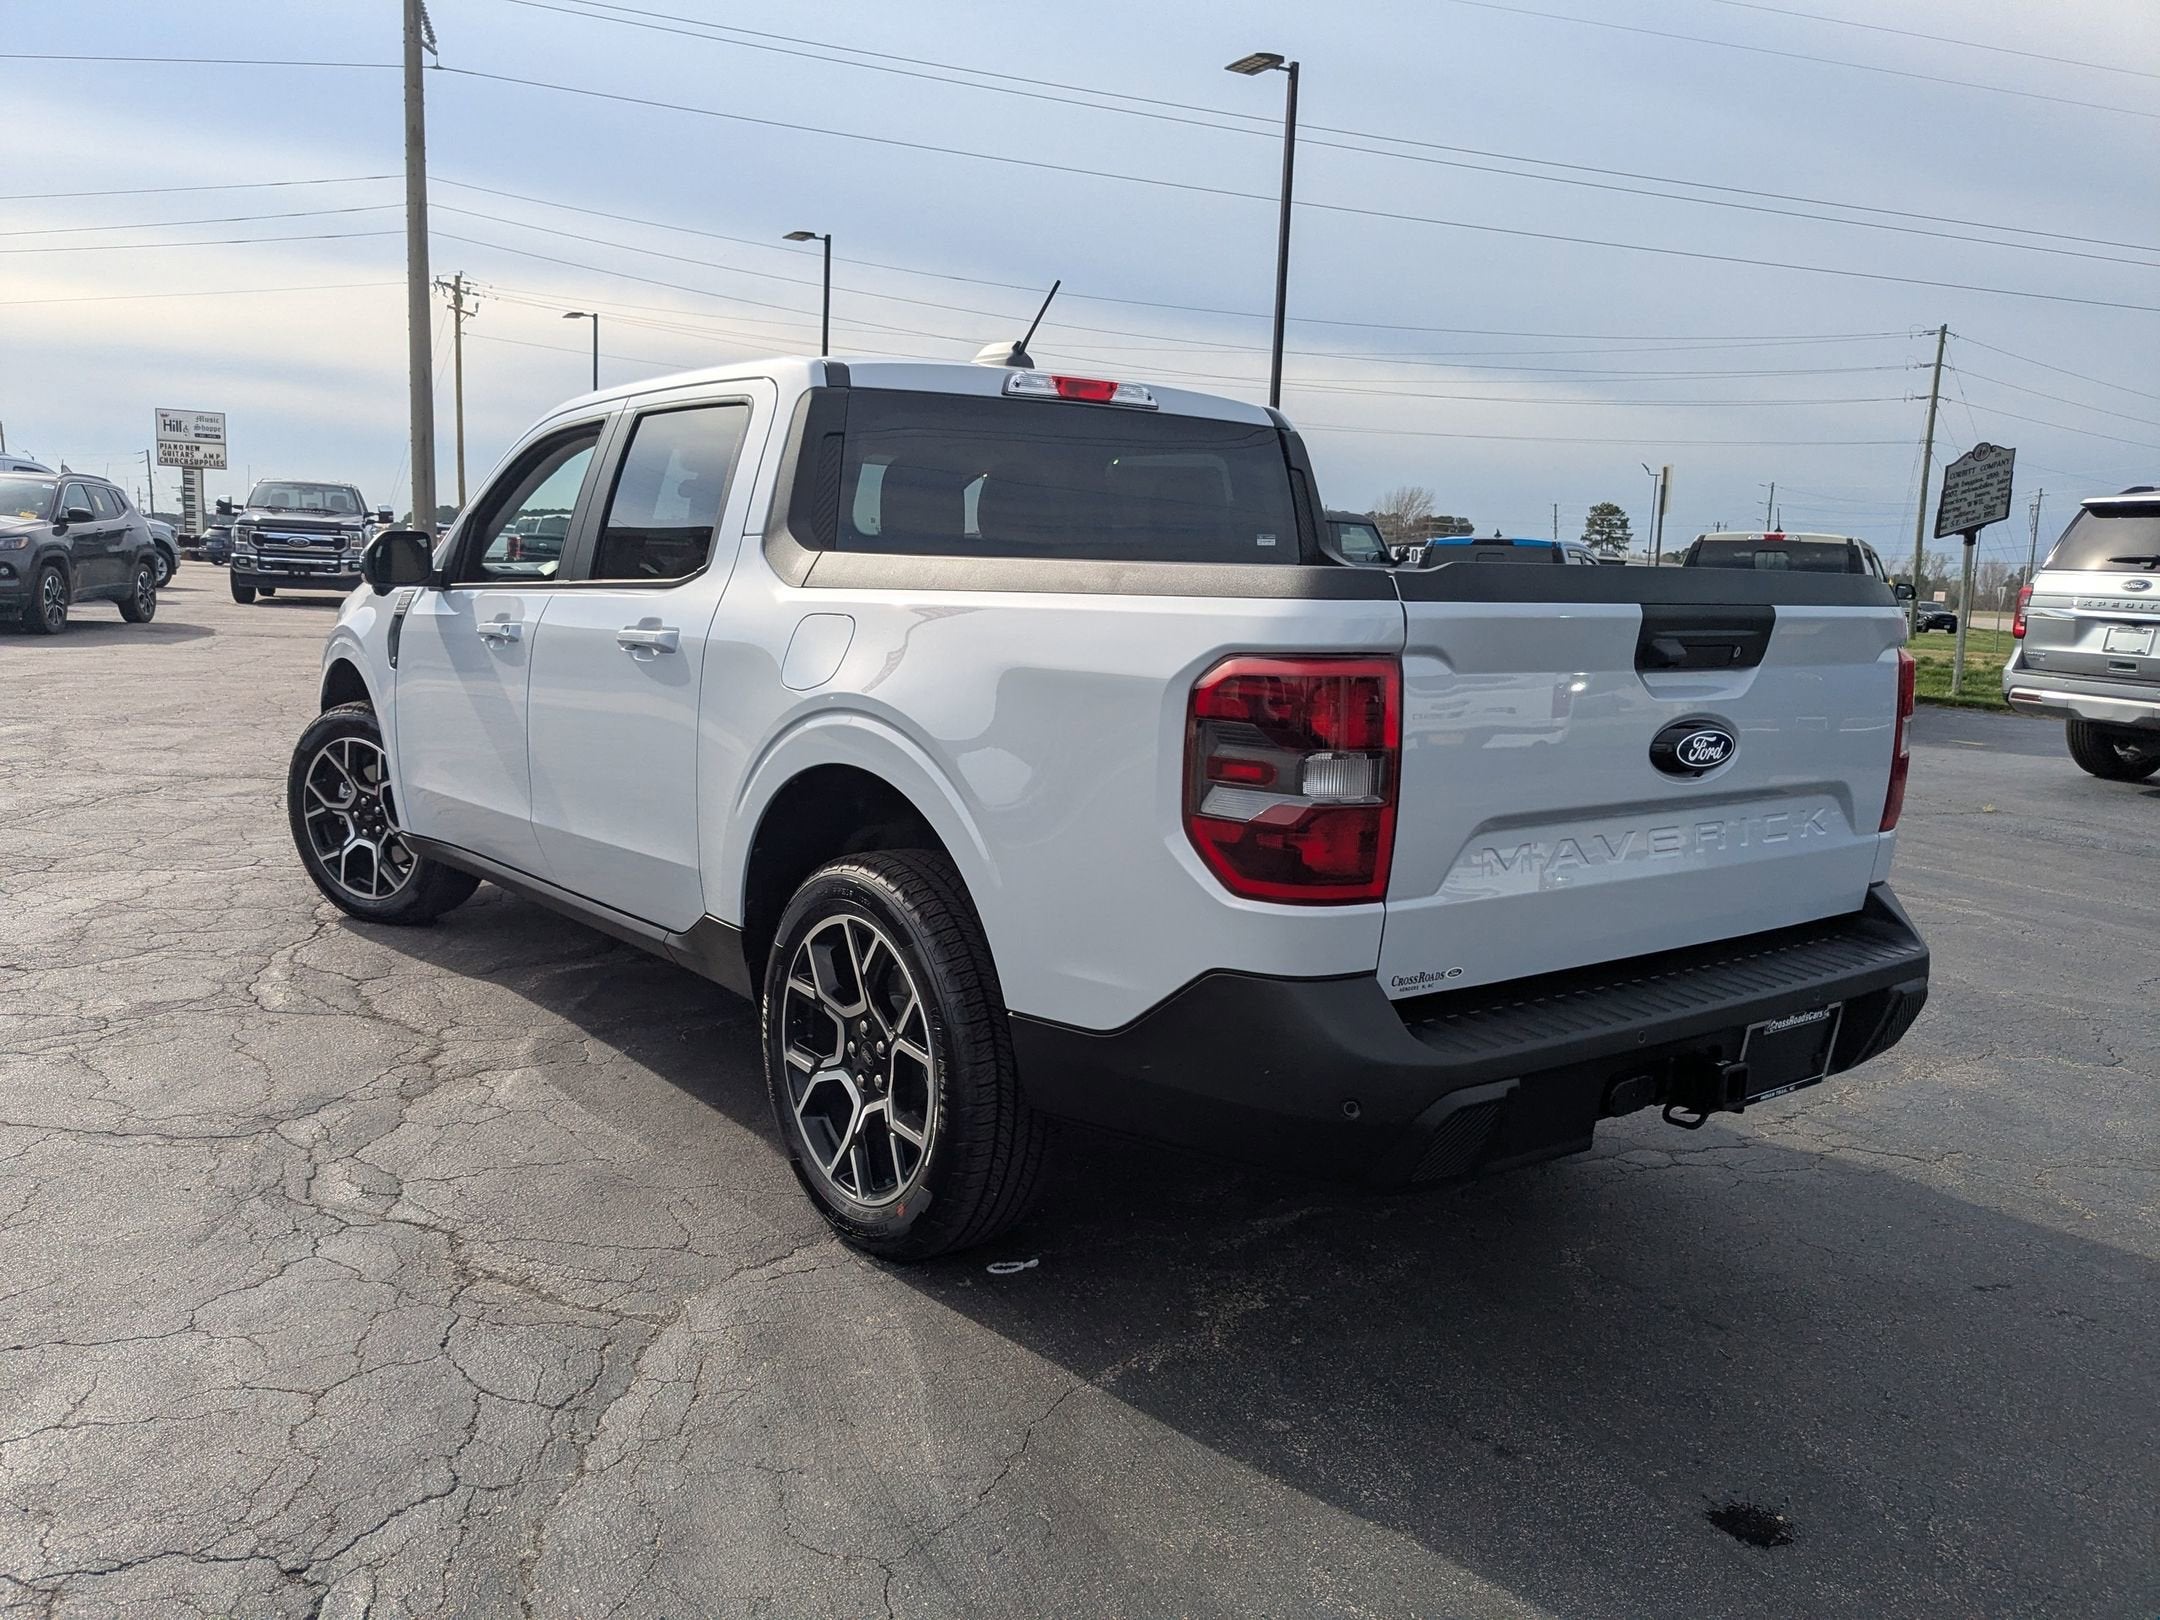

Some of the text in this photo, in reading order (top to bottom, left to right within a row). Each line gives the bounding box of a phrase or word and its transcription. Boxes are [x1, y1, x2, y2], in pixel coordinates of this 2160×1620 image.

[163, 419, 184, 433] Hill
[195, 416, 220, 424] Music
[193, 424, 222, 433] Shoppe
[162, 450, 195, 458] GUITARS
[159, 457, 225, 467] CHURCH SUPPLIES
[1980, 458, 2011, 472] COMPANY
[1687, 736, 1725, 762] Ford
[1481, 807, 1828, 881] MAVERICK
